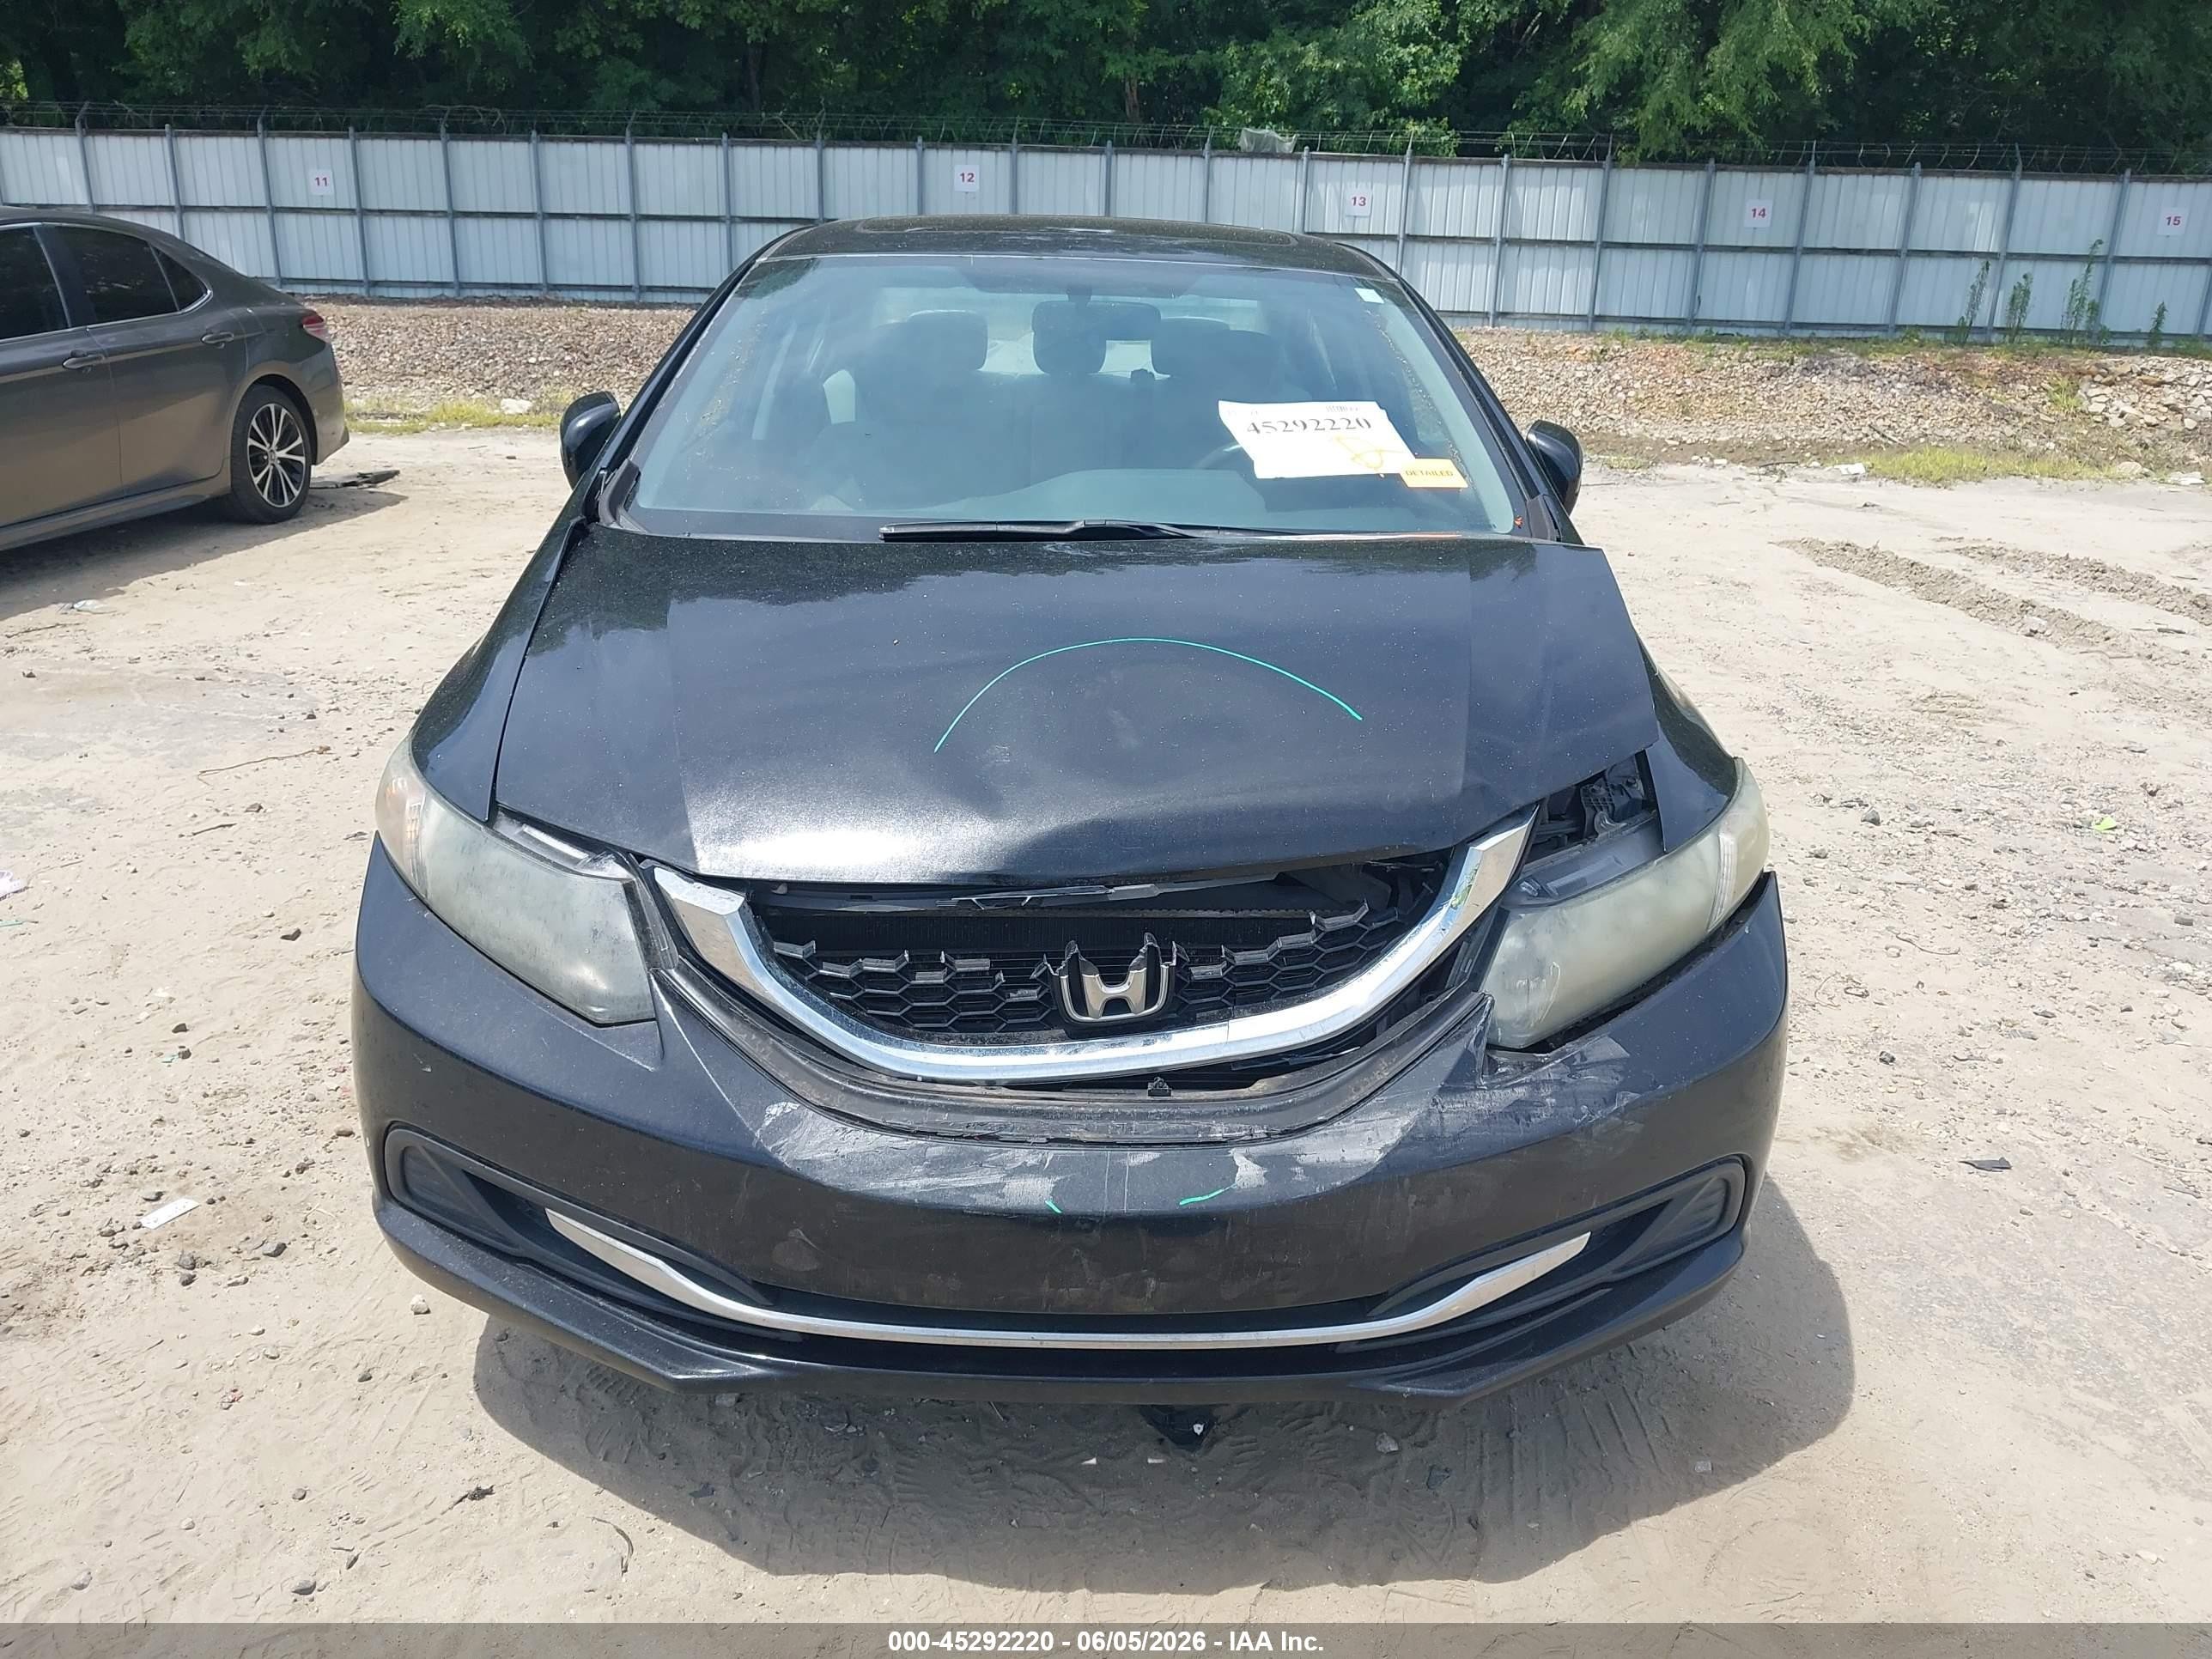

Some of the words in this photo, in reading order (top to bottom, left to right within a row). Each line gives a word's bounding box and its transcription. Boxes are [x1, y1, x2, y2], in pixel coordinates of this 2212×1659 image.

[314, 176, 328, 186] 11
[959, 172, 975, 183] 12
[1352, 196, 1367, 207] 13
[1751, 208, 1766, 218] 14
[2166, 216, 2181, 226] 15
[1247, 416, 1371, 435] 45292220
